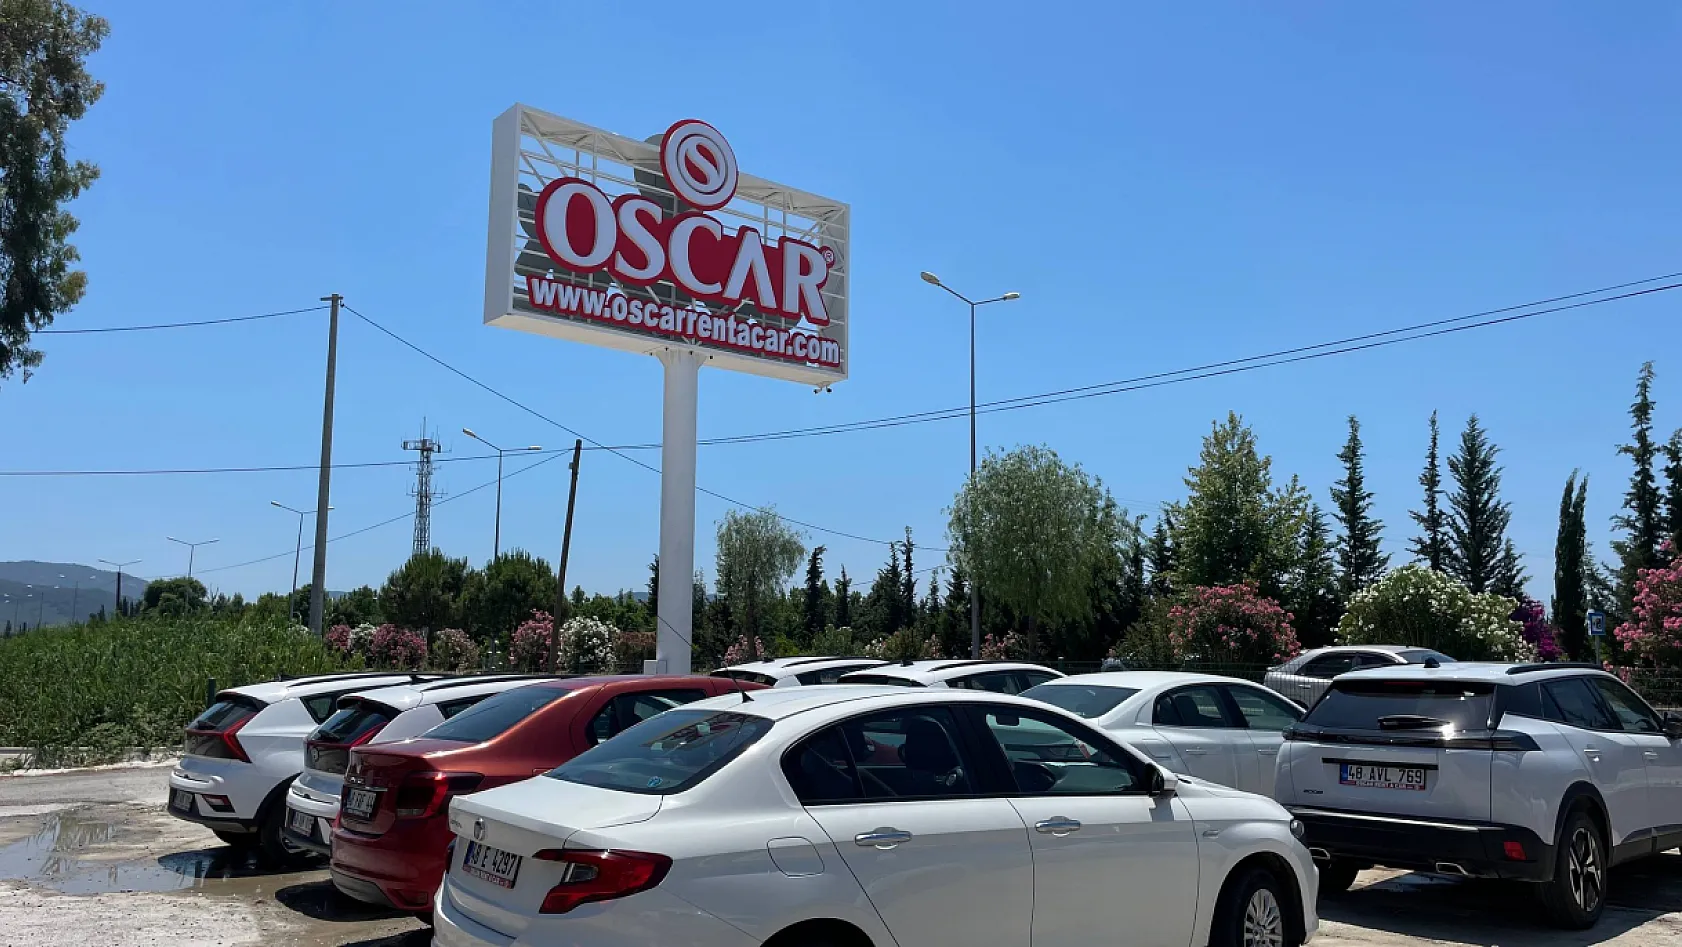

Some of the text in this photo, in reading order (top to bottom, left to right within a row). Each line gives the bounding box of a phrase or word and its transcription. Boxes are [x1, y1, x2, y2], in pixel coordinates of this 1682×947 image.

[539, 180, 831, 323] OSCAR
[530, 277, 840, 366] www.oscarrentacar.com
[1349, 766, 1422, 784] 48 AVL 769
[492, 848, 518, 876] 4297
